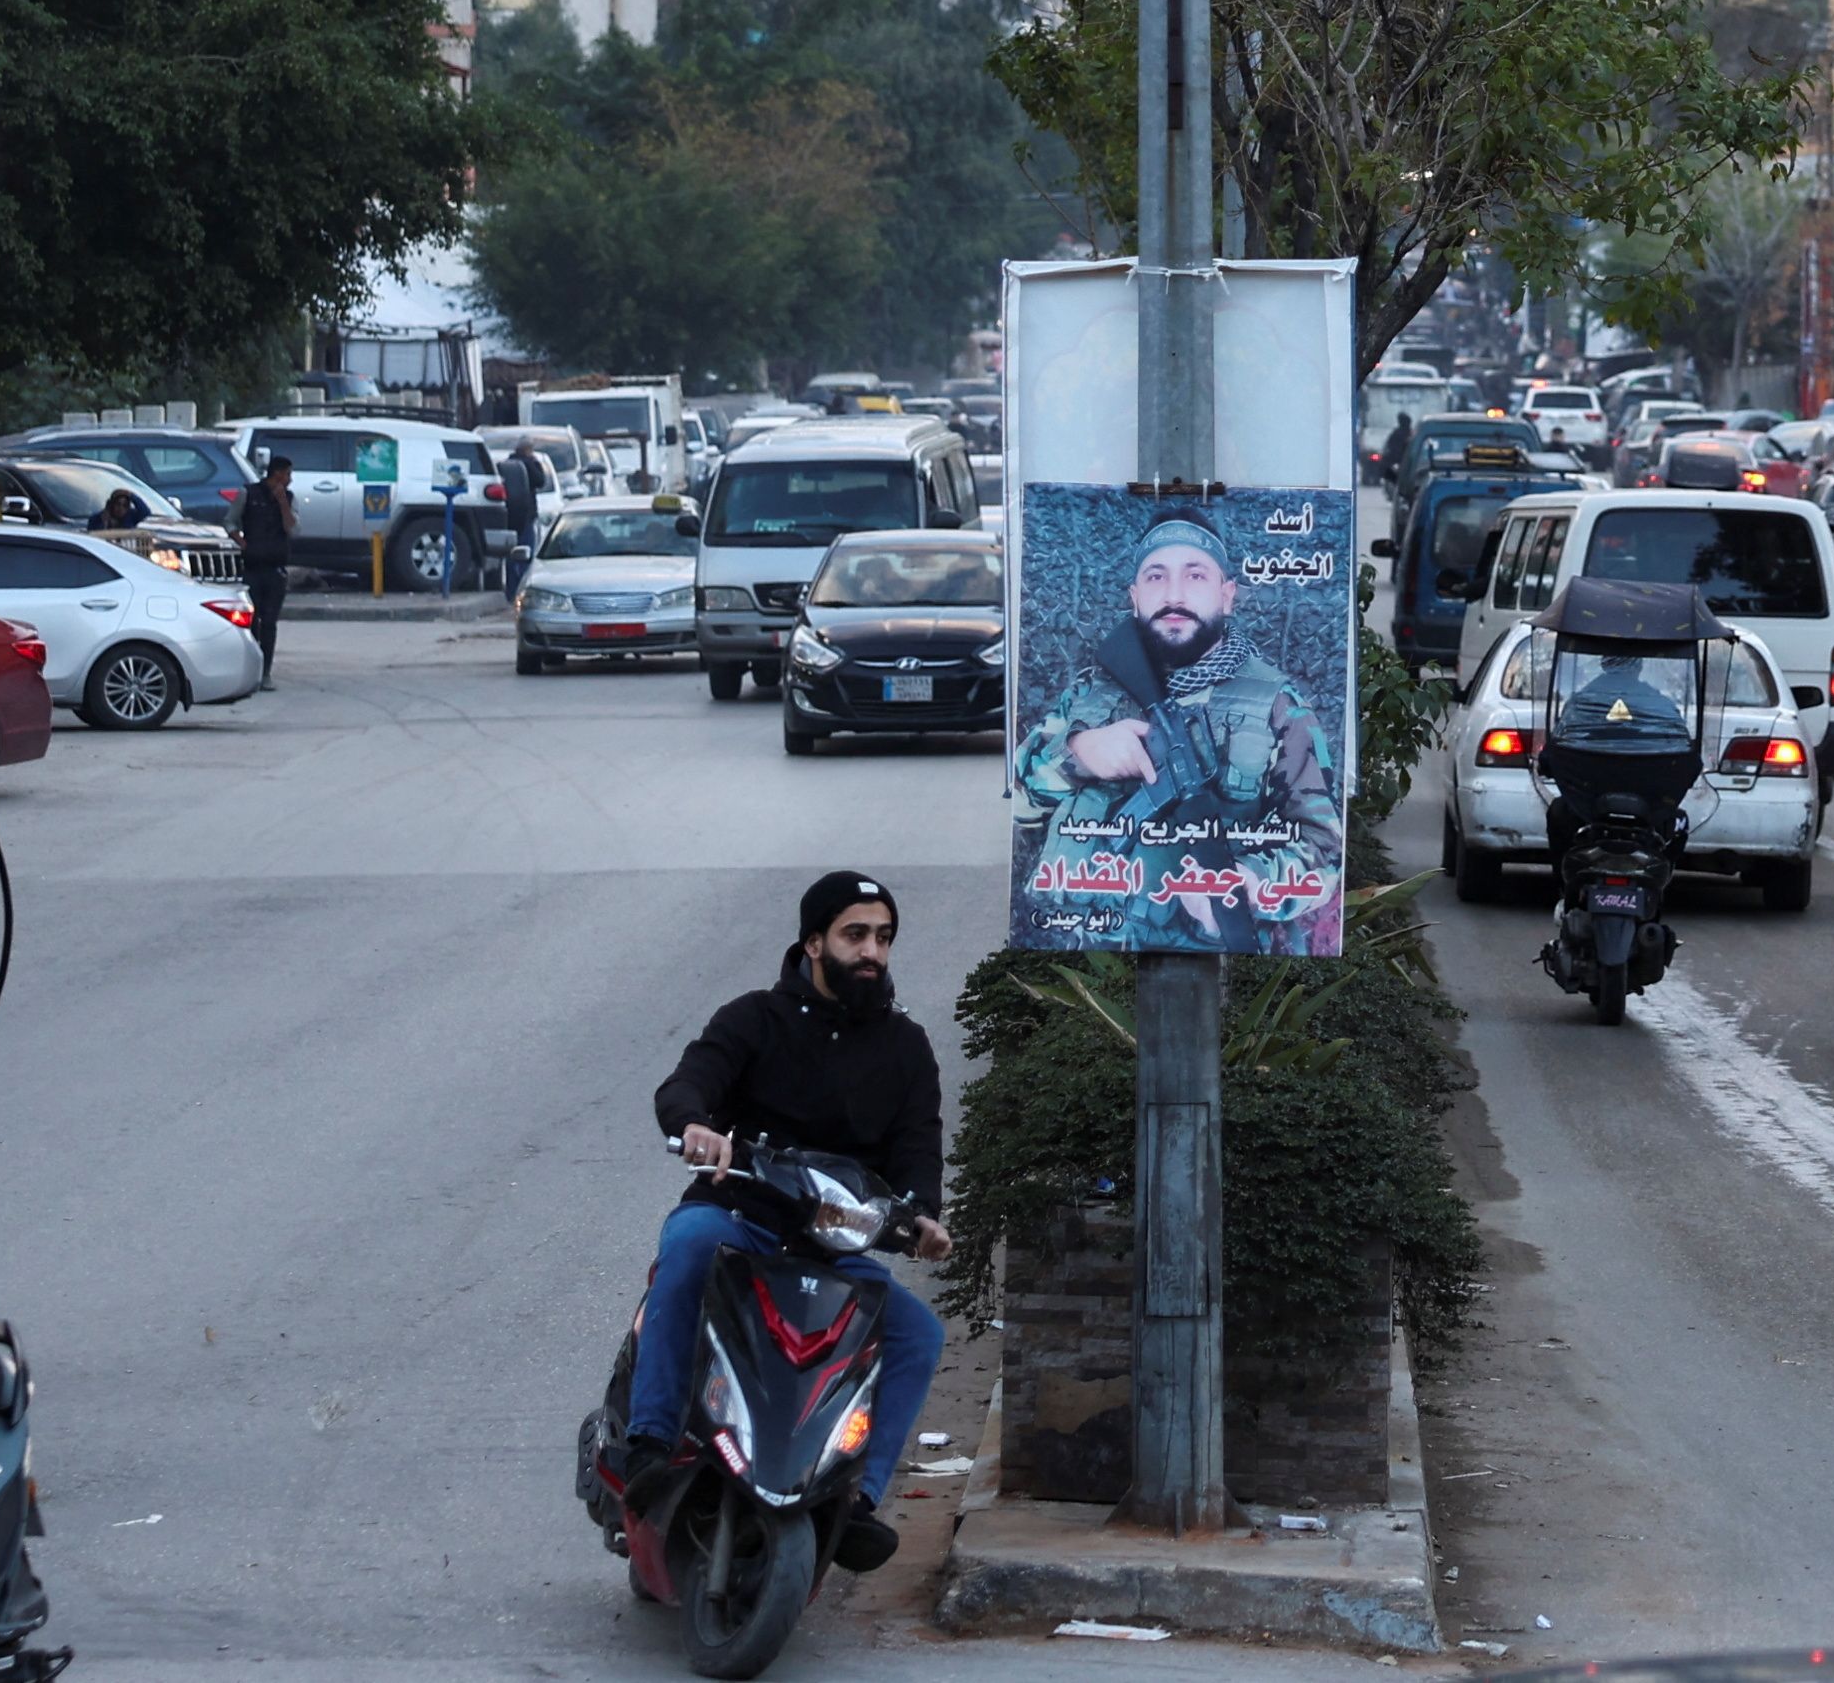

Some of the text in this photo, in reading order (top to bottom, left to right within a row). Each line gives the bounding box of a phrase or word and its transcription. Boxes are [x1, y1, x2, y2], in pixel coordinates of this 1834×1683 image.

[1266, 503, 1314, 535] أسد
[1243, 547, 1334, 586] الجنوب
[1058, 814, 1134, 842] السعيد
[1140, 818, 1219, 846] الجريح
[1032, 851, 1325, 912] علي جعفر المقداد
